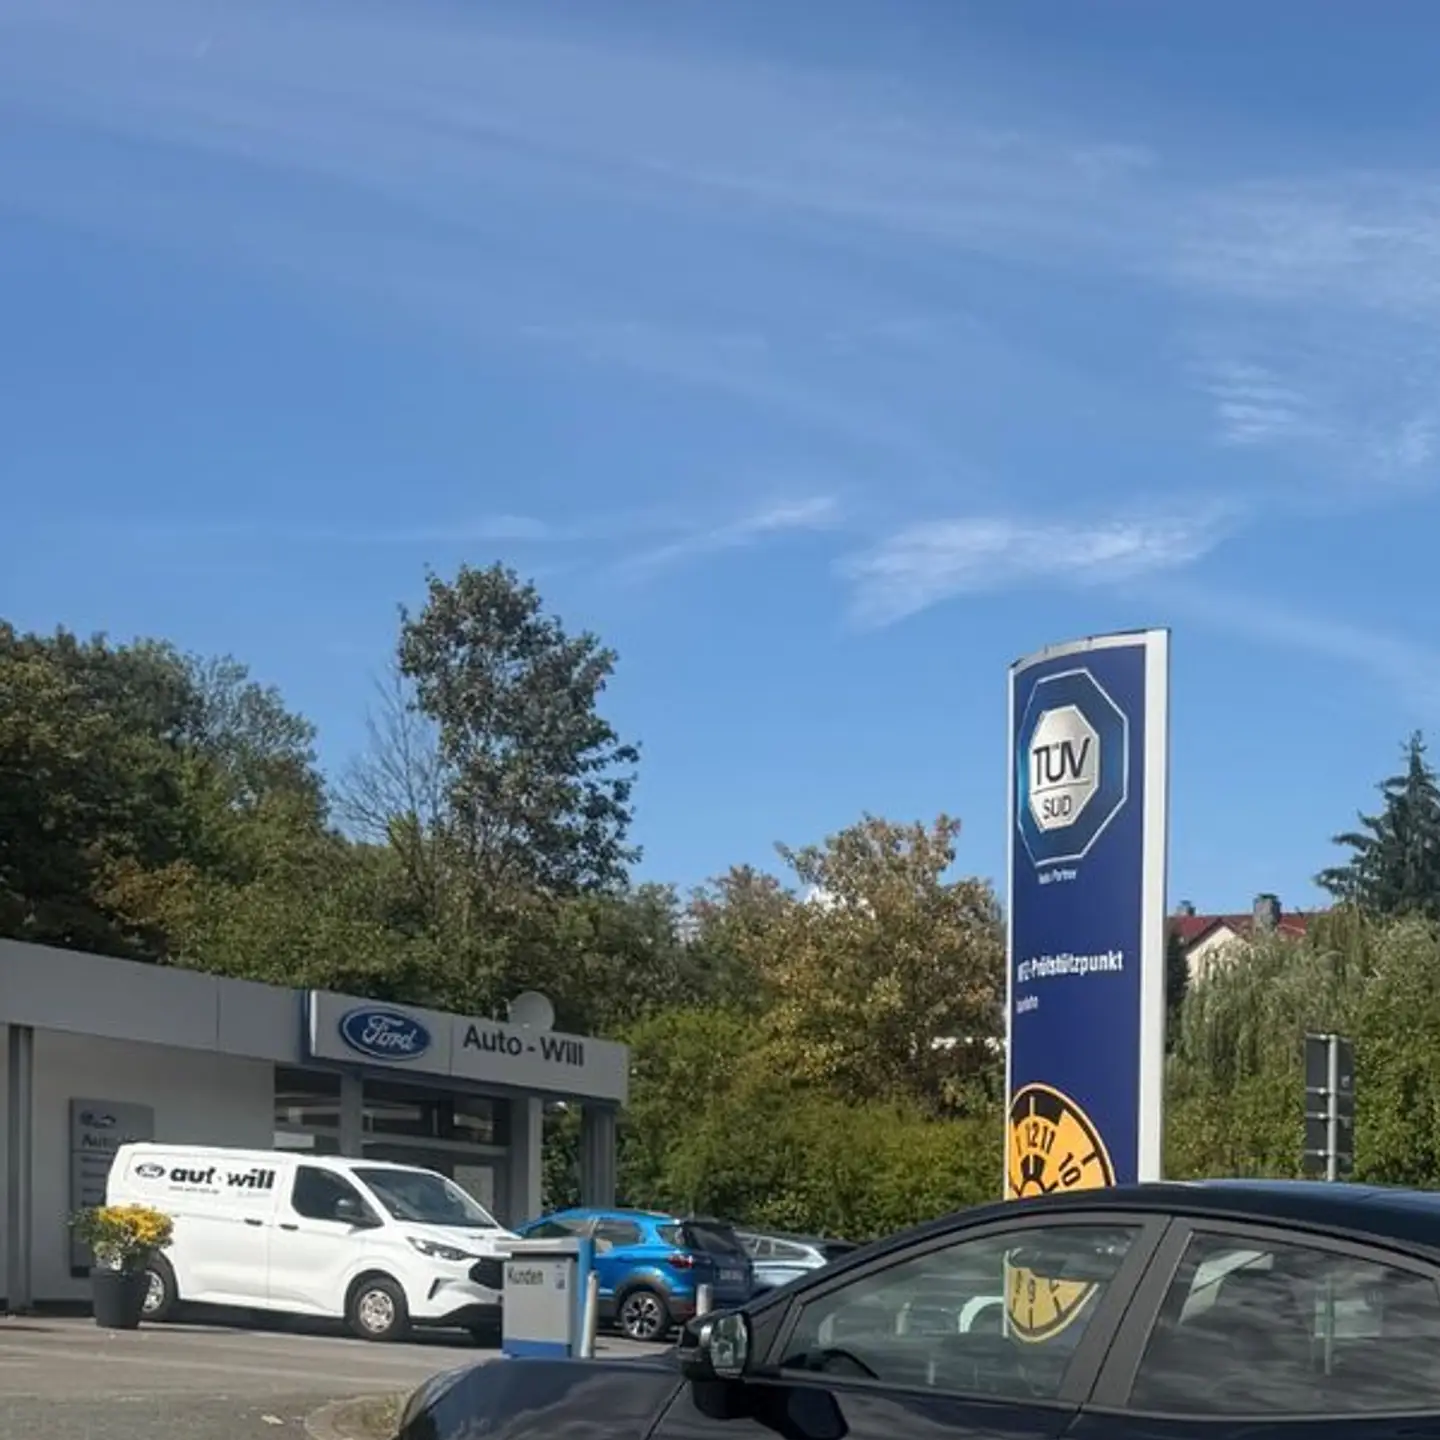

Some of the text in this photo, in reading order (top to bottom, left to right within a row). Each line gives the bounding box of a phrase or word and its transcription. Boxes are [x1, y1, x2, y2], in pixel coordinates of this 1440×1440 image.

[1032, 737, 1091, 786] TÜV
[361, 1016, 418, 1051] Ford
[463, 1025, 522, 1056] Auto
[540, 1036, 585, 1067] Will
[1026, 1121, 1040, 1149] 12
[1041, 1125, 1056, 1156] 11
[1059, 1152, 1081, 1187] 10
[226, 1168, 276, 1189] will
